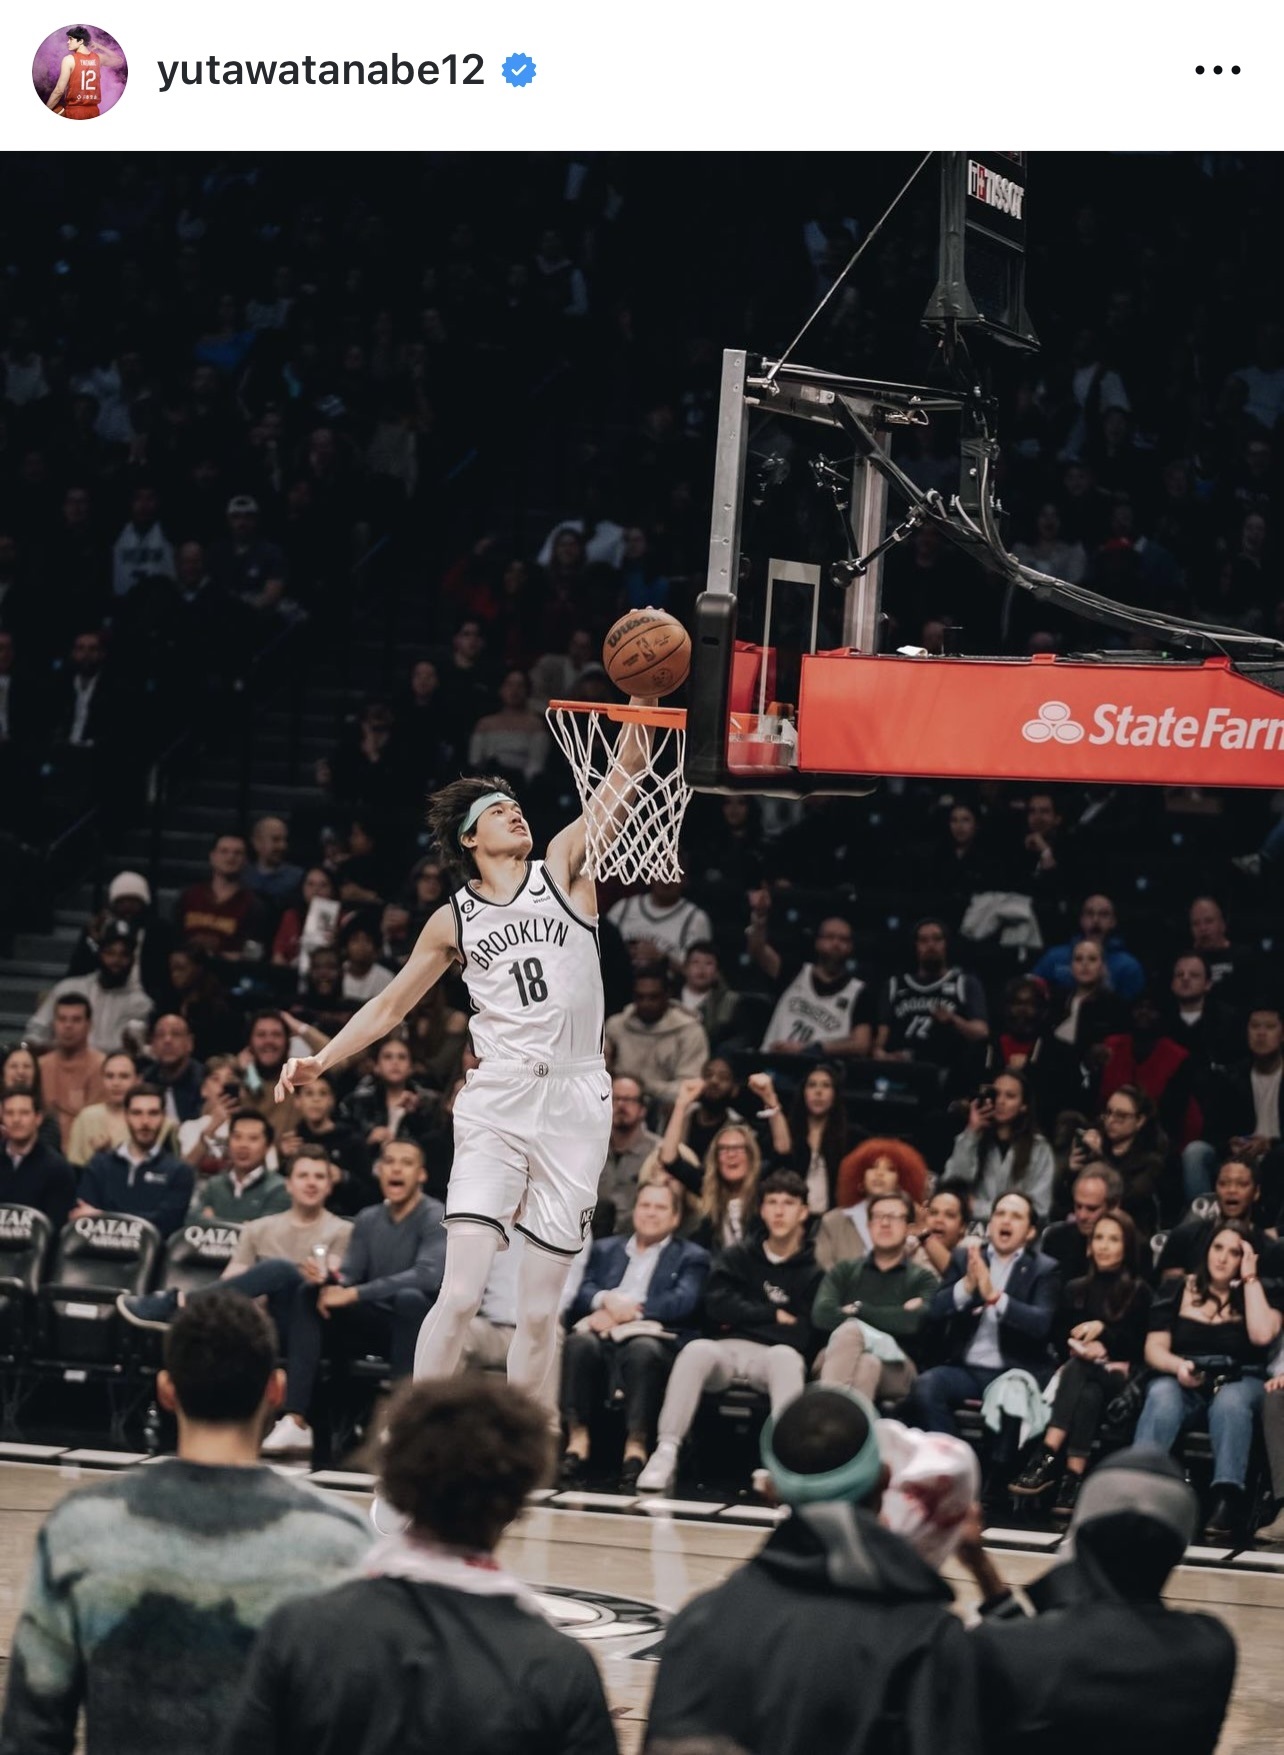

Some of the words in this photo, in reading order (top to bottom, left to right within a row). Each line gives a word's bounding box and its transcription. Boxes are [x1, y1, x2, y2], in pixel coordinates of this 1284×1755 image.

[81, 70, 97, 90] 12
[984, 167, 1025, 220] TISSOT
[470, 917, 569, 970] BROOKLYN
[508, 957, 549, 1007] 18
[0, 1209, 33, 1228] TAR
[74, 1217, 144, 1240] QATAR
[184, 1225, 240, 1248] QATA
